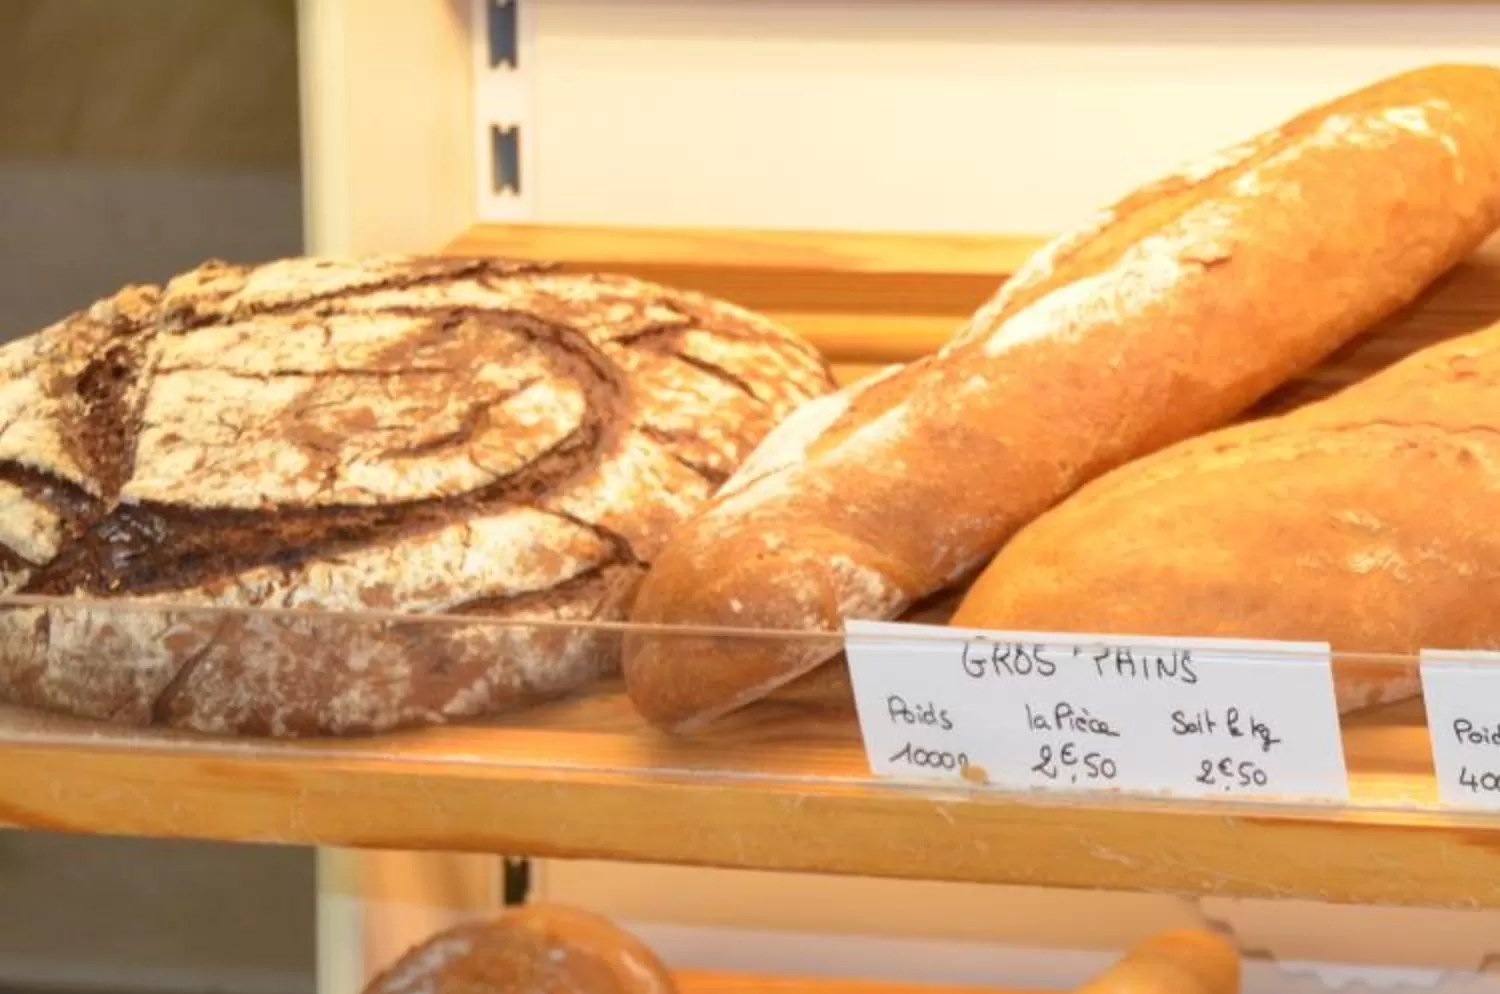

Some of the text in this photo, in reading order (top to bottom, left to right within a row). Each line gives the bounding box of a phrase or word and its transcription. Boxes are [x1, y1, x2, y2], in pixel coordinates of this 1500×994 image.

[962, 637, 1199, 684] GROS PAINS
[887, 695, 953, 731] Poids
[1026, 703, 1050, 730] la
[1055, 702, 1120, 737] Pièce
[1227, 707, 1244, 737] le
